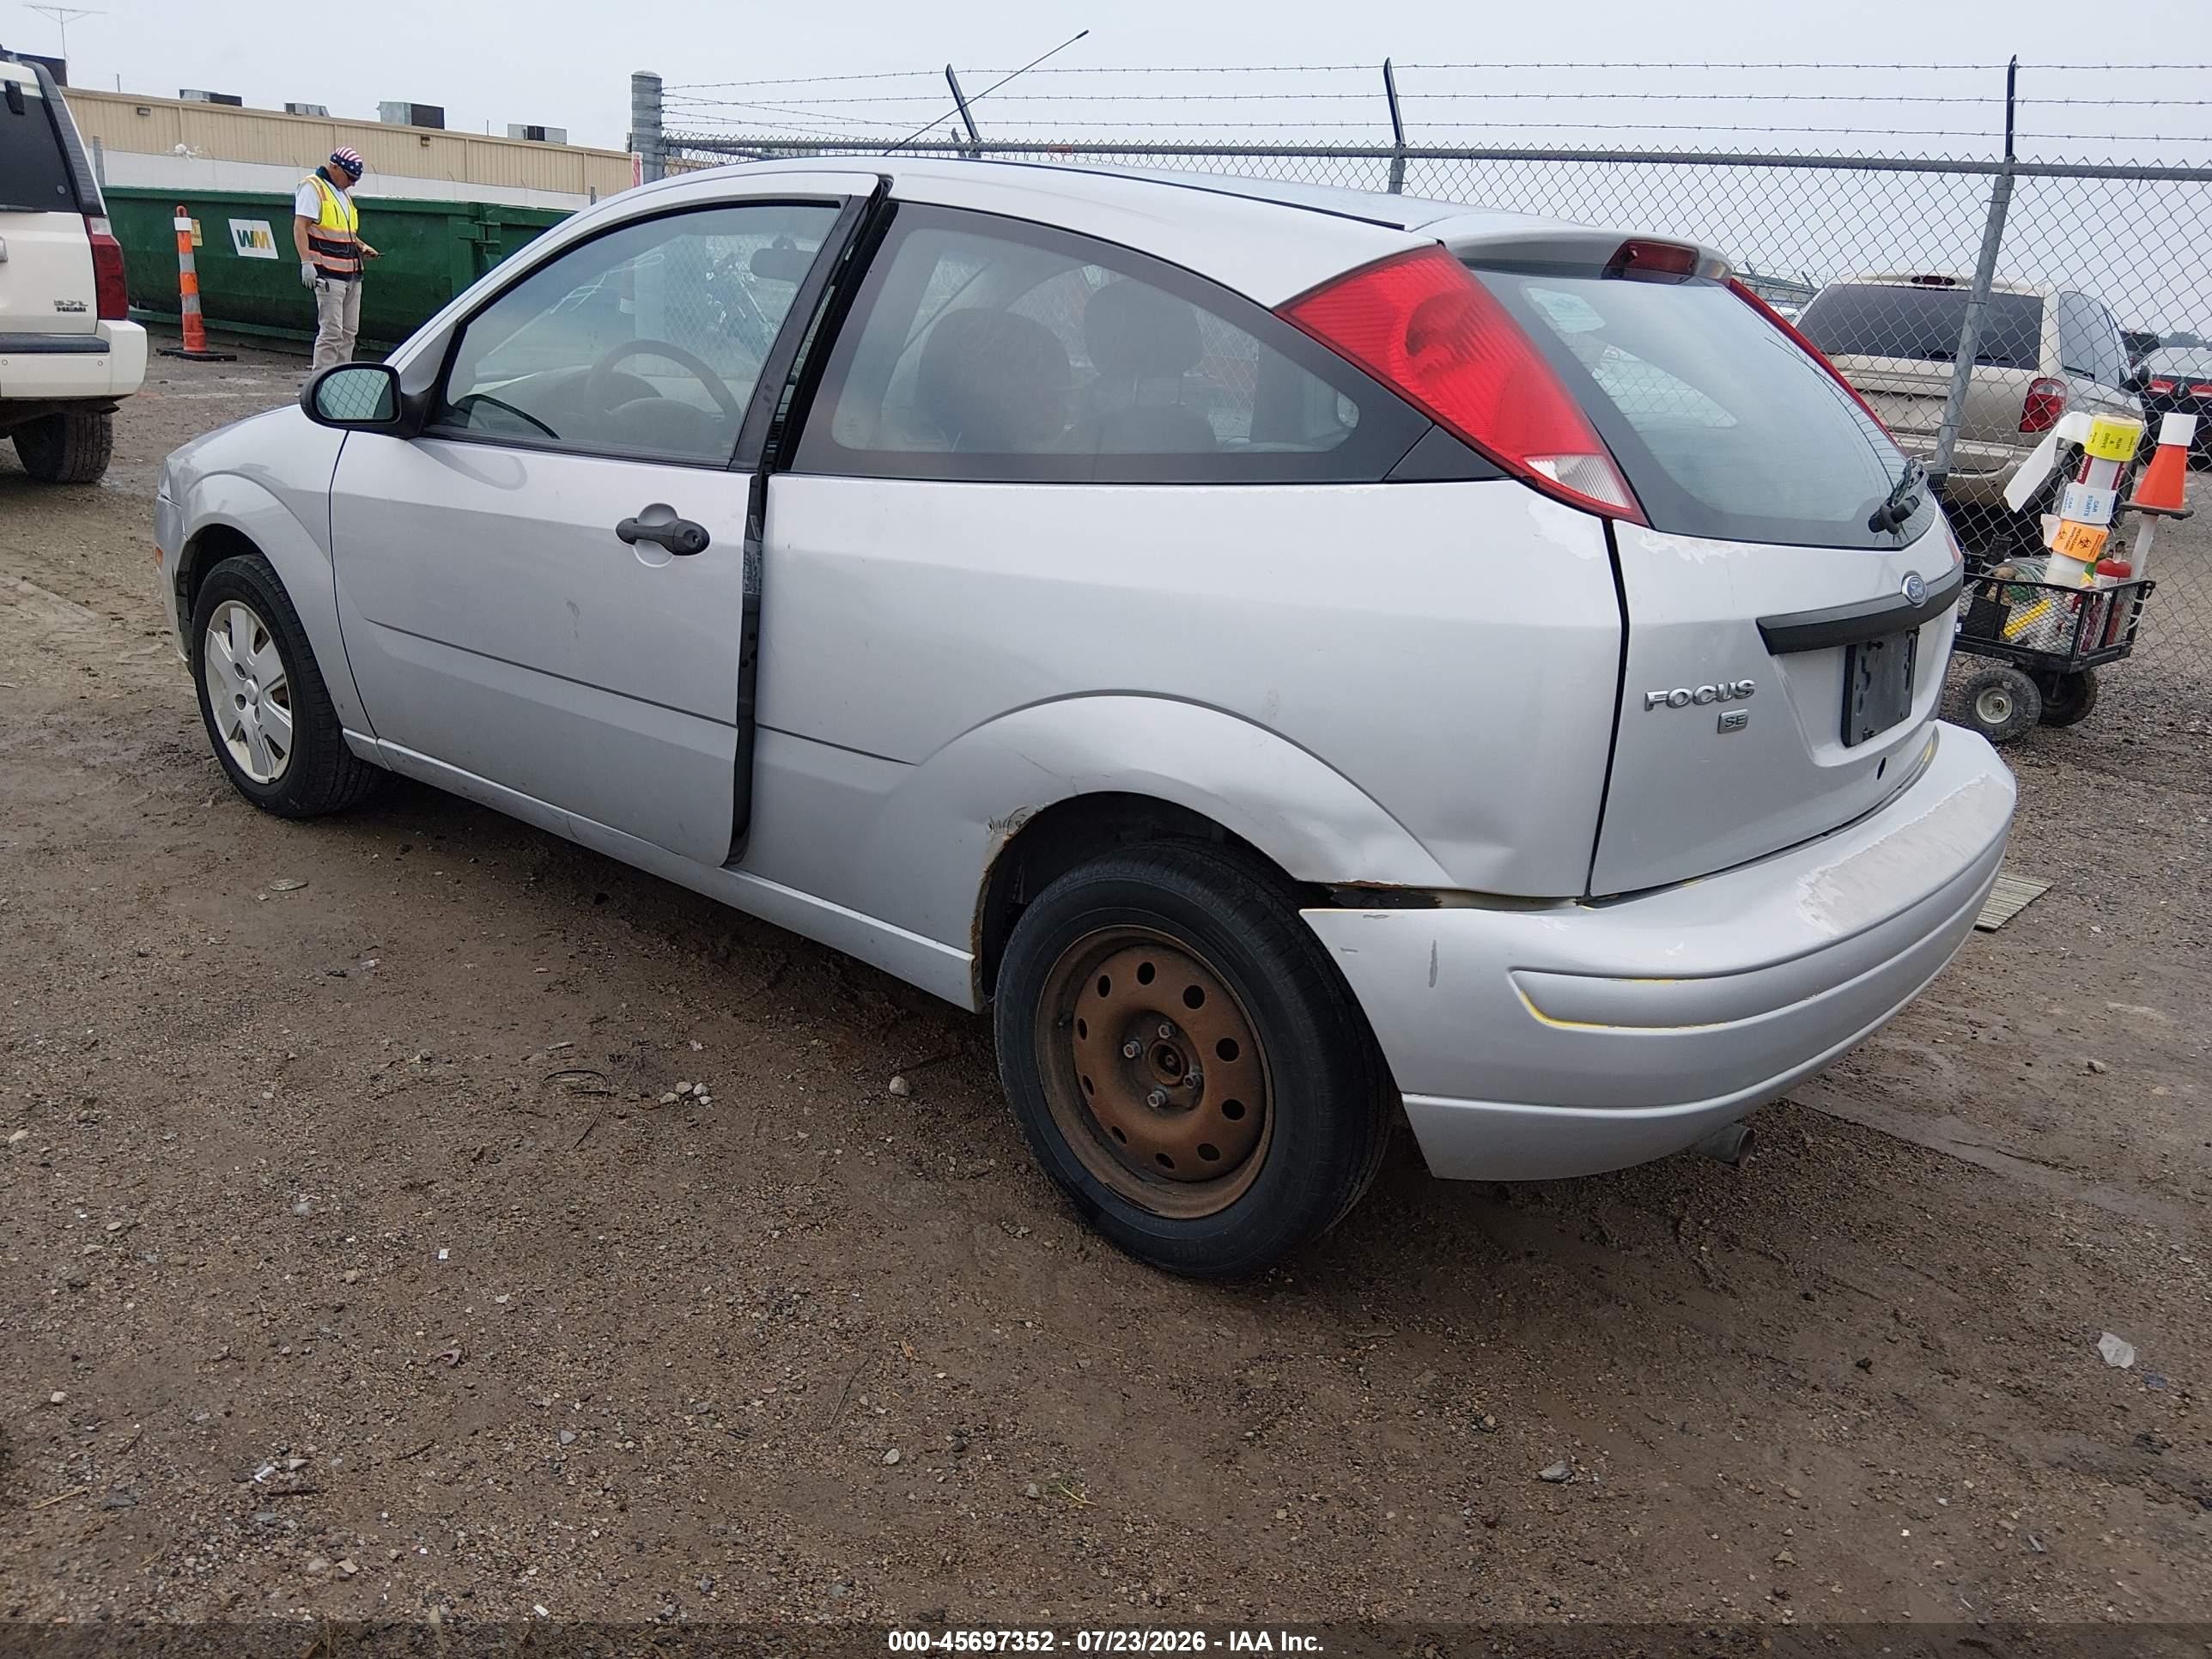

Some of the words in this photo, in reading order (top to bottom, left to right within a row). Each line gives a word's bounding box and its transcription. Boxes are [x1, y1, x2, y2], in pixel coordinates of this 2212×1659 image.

[236, 228, 272, 250] WM
[1644, 679, 1756, 711] FOCUS
[1724, 714, 1747, 728] SE
